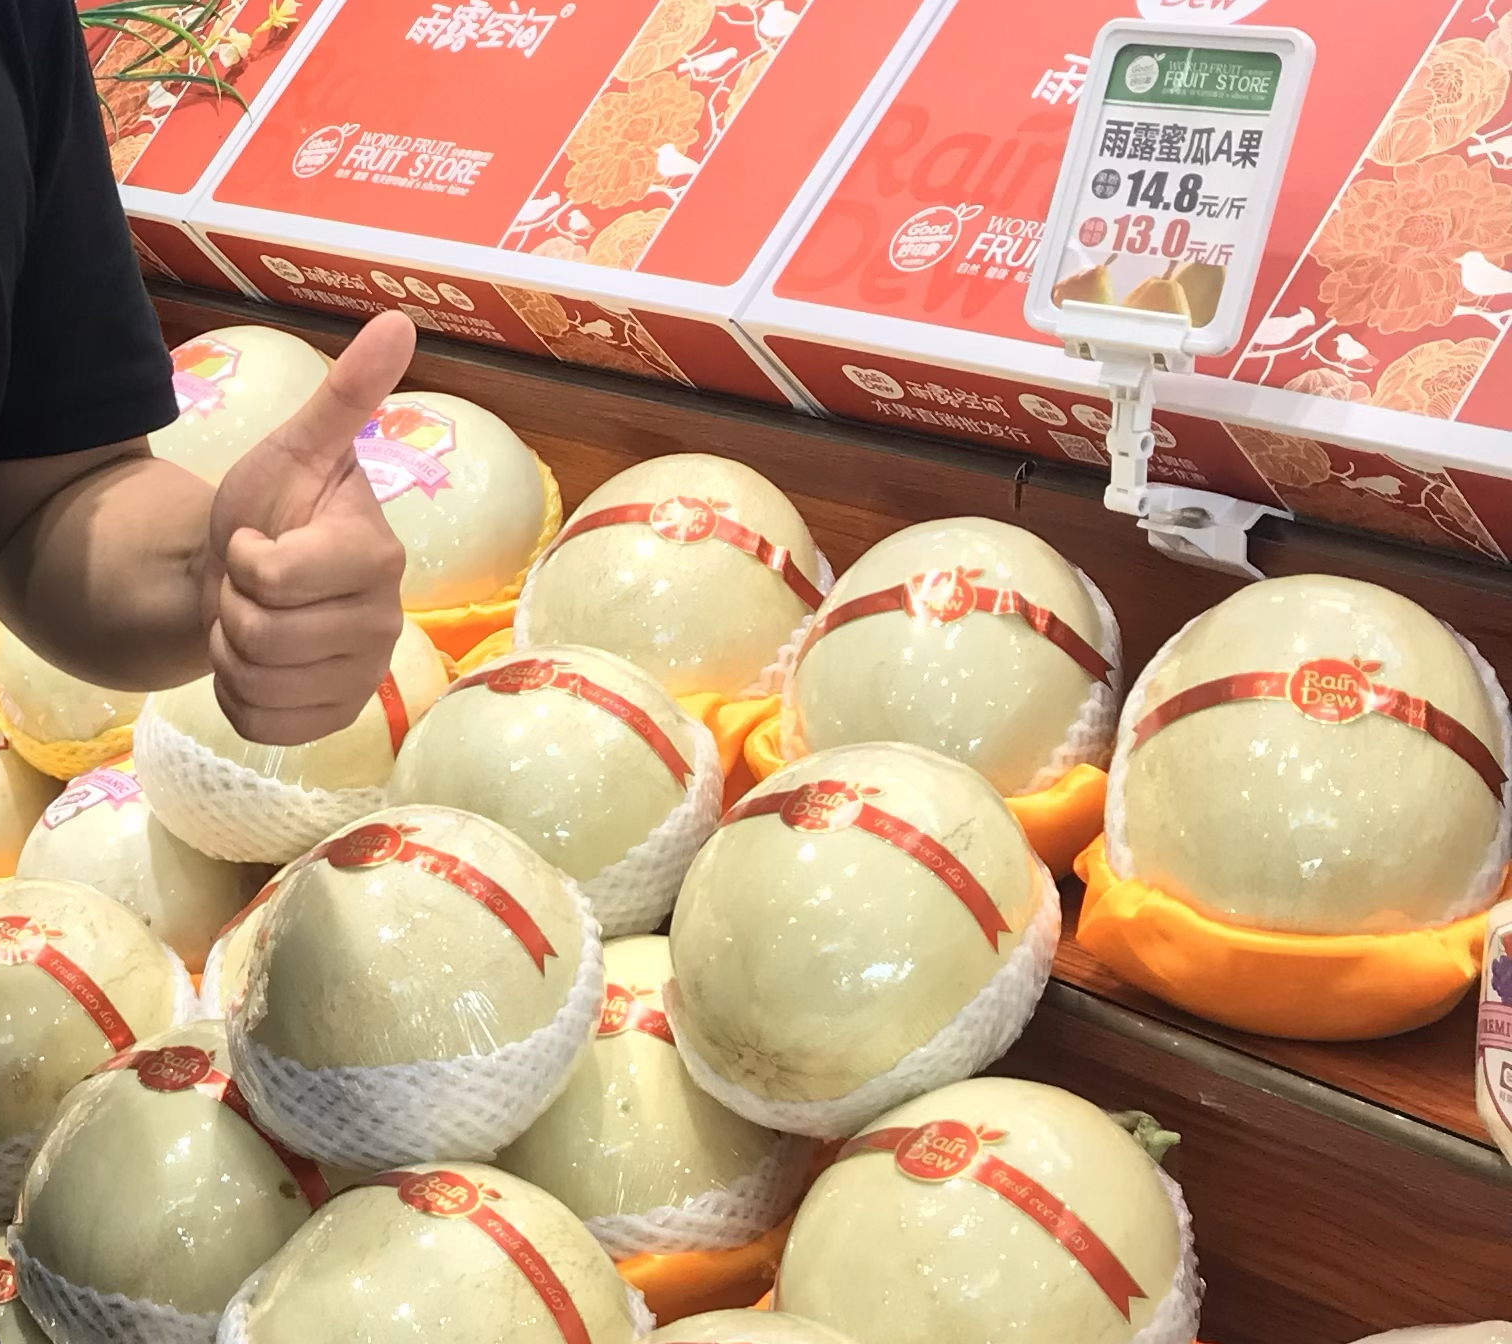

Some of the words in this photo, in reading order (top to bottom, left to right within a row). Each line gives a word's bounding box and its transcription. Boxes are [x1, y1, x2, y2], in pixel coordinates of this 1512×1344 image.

[1169, 60, 1209, 74] WORLD
[1209, 62, 1243, 77] FRUIT
[1163, 70, 1210, 89] FRUIT
[1215, 74, 1271, 93] STORE
[360, 131, 413, 150] WORLD
[411, 137, 457, 156] FRUIT
[1099, 119, 1264, 169] 雨露蜜瓜A果
[342, 144, 409, 174] FRUIT
[408, 153, 488, 185] STORE
[907, 221, 953, 236] Good
[1303, 668, 1360, 691] Rain
[1301, 686, 1358, 710] Dew
[945, 865, 968, 890] day
[50, 958, 79, 987] Fresh
[98, 1008, 118, 1031] day
[147, 1061, 191, 1085] Dew
[157, 1050, 201, 1075] Rain
[409, 1183, 459, 1211] Dew
[427, 1175, 469, 1204] Rain
[990, 1168, 1033, 1200] Fresh
[1028, 1196, 1067, 1229] every
[1063, 1226, 1090, 1253] day
[487, 1218, 523, 1251] Fresh
[518, 1250, 549, 1286] every
[545, 1285, 567, 1312] day
